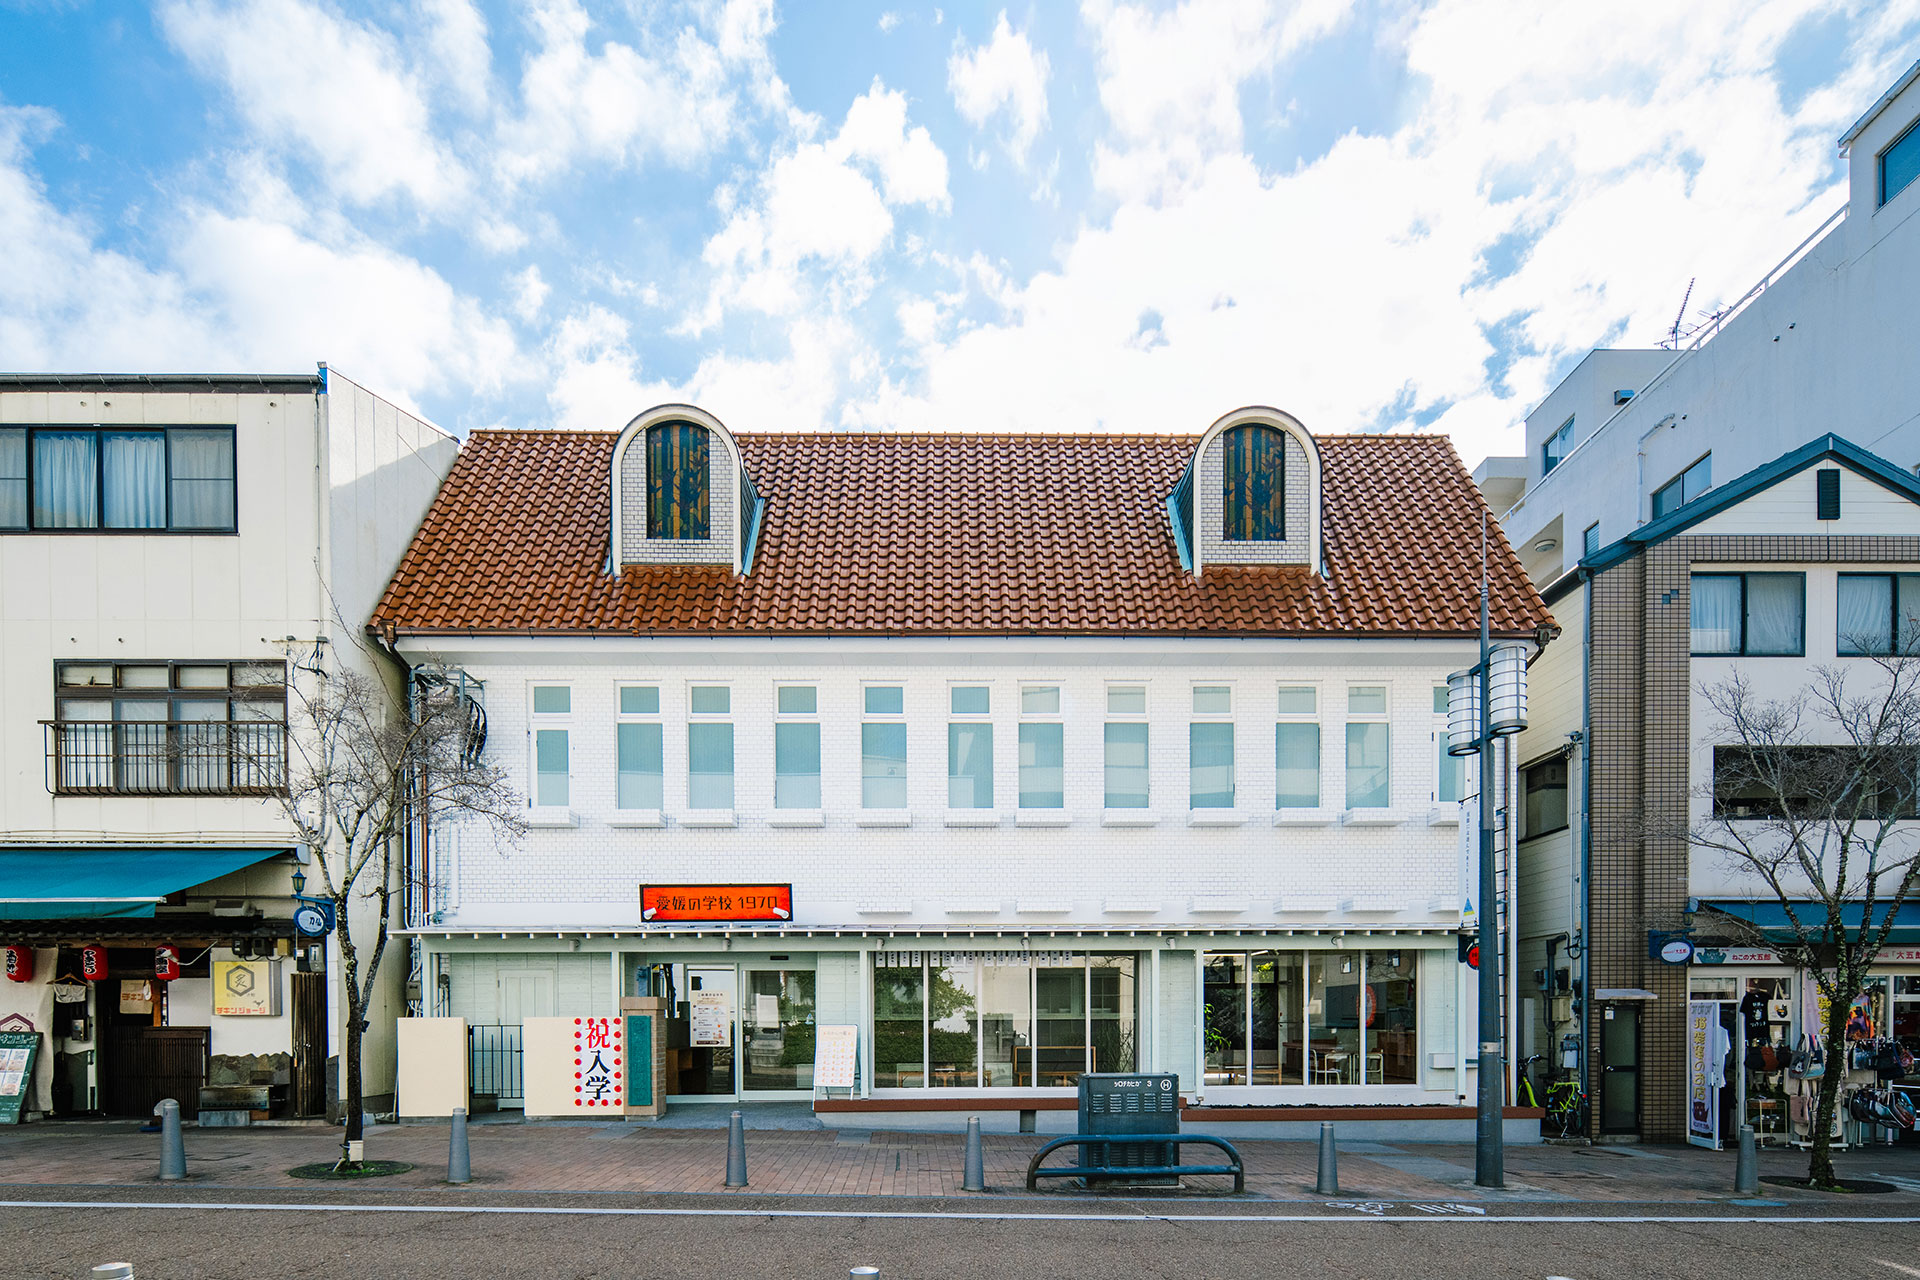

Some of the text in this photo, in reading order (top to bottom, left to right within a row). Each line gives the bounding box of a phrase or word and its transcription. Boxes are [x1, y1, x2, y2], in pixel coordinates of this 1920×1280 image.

[656, 895, 778, 911] 愛媛の学校 1970
[1732, 953, 1771, 961] ねこの大五郎
[585, 1023, 611, 1100] 祝入学
